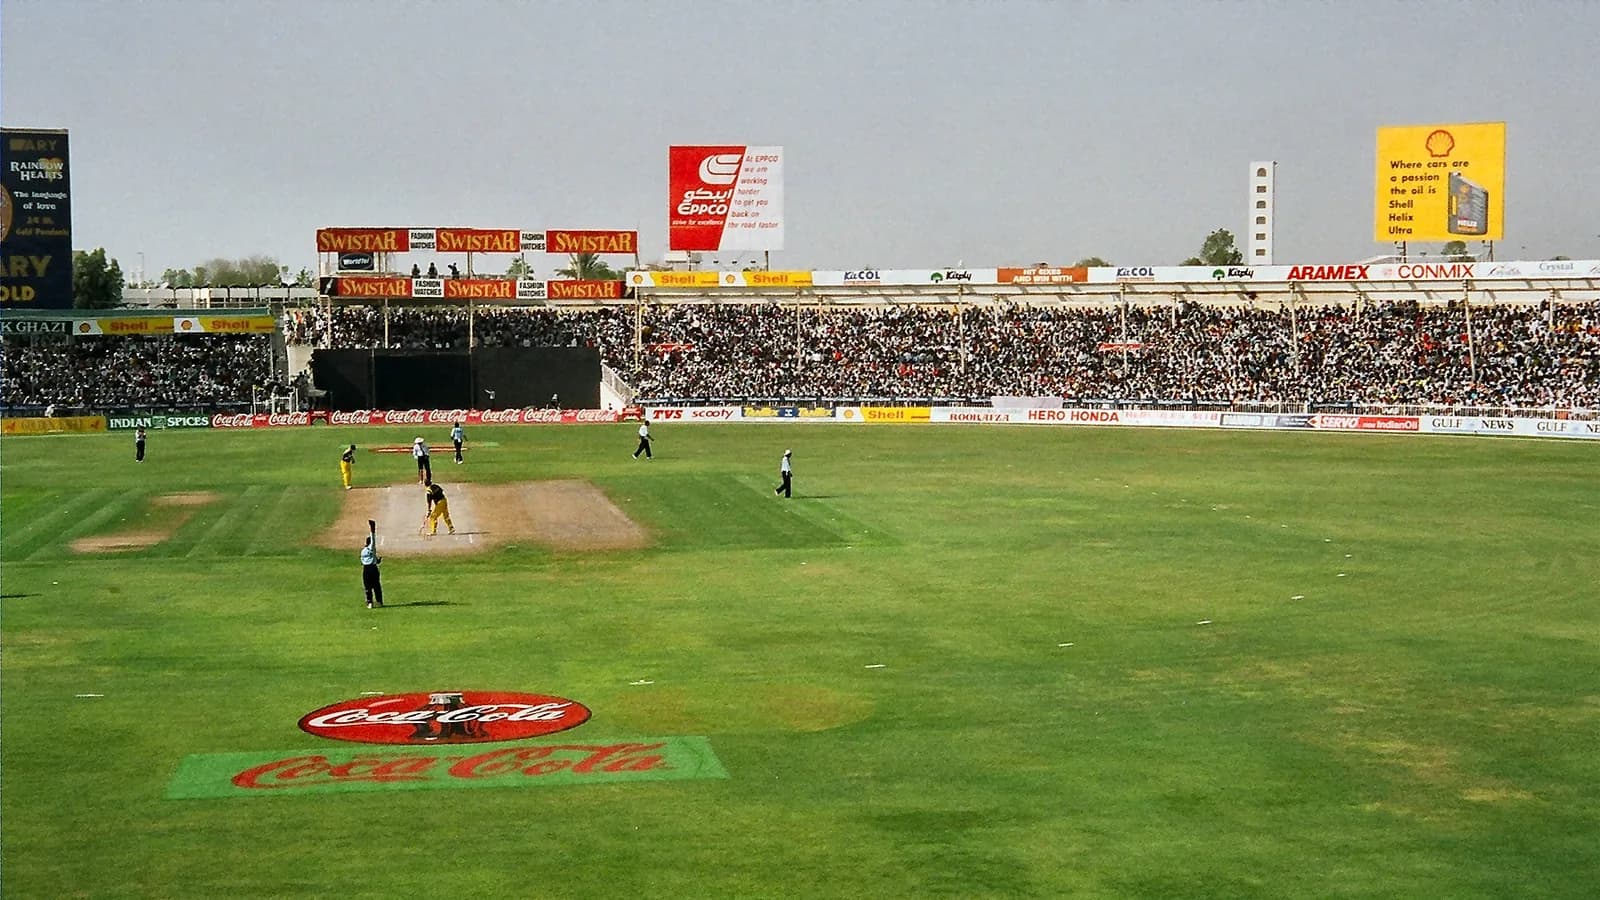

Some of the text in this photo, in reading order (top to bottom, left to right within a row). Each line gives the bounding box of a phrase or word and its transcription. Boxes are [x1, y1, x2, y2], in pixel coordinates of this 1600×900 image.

[10, 161, 63, 172] RAINBOW
[1391, 160, 1422, 169] Where
[1453, 160, 1469, 168] are
[20, 170, 63, 181] HEARTS
[1402, 173, 1439, 183] passion
[1391, 186, 1436, 195] the oil is
[23, 202, 56, 210] of love
[1389, 200, 1413, 209] Shell
[1389, 213, 1414, 221] Helix
[1389, 226, 1412, 234] Ultra
[320, 231, 398, 250] SWISTAR
[440, 231, 516, 250] SWISTAR
[555, 232, 633, 251] SWISTAR
[1227, 267, 1254, 279] Kitply
[1288, 265, 1370, 280] ARAMEX
[1398, 264, 1474, 279] CONMIX
[1539, 263, 1573, 272] Crystal
[660, 275, 696, 284] Shell
[753, 274, 788, 284] Shell
[945, 271, 972, 282] Kitply
[342, 280, 407, 296] SWISTAR
[449, 280, 512, 297] SWISTAR
[552, 282, 616, 297] SWISTAR
[16, 322, 66, 332] GHAZI
[110, 320, 148, 330] Shell
[212, 320, 249, 330] Shell
[653, 410, 683, 419] TVS
[692, 409, 733, 419] scooty
[868, 410, 904, 419] Shell
[1028, 410, 1065, 421] HERO
[1070, 411, 1119, 422] HONDA
[110, 416, 209, 428] INDIAN SPICES
[1321, 416, 1358, 428] SERVO
[1377, 420, 1417, 430] IndianOil
[1432, 418, 1514, 430] GULF NEWS
[1537, 421, 1566, 432] GULF
[308, 702, 571, 727] Coca-Cola
[232, 742, 668, 788] Coca-Cola
